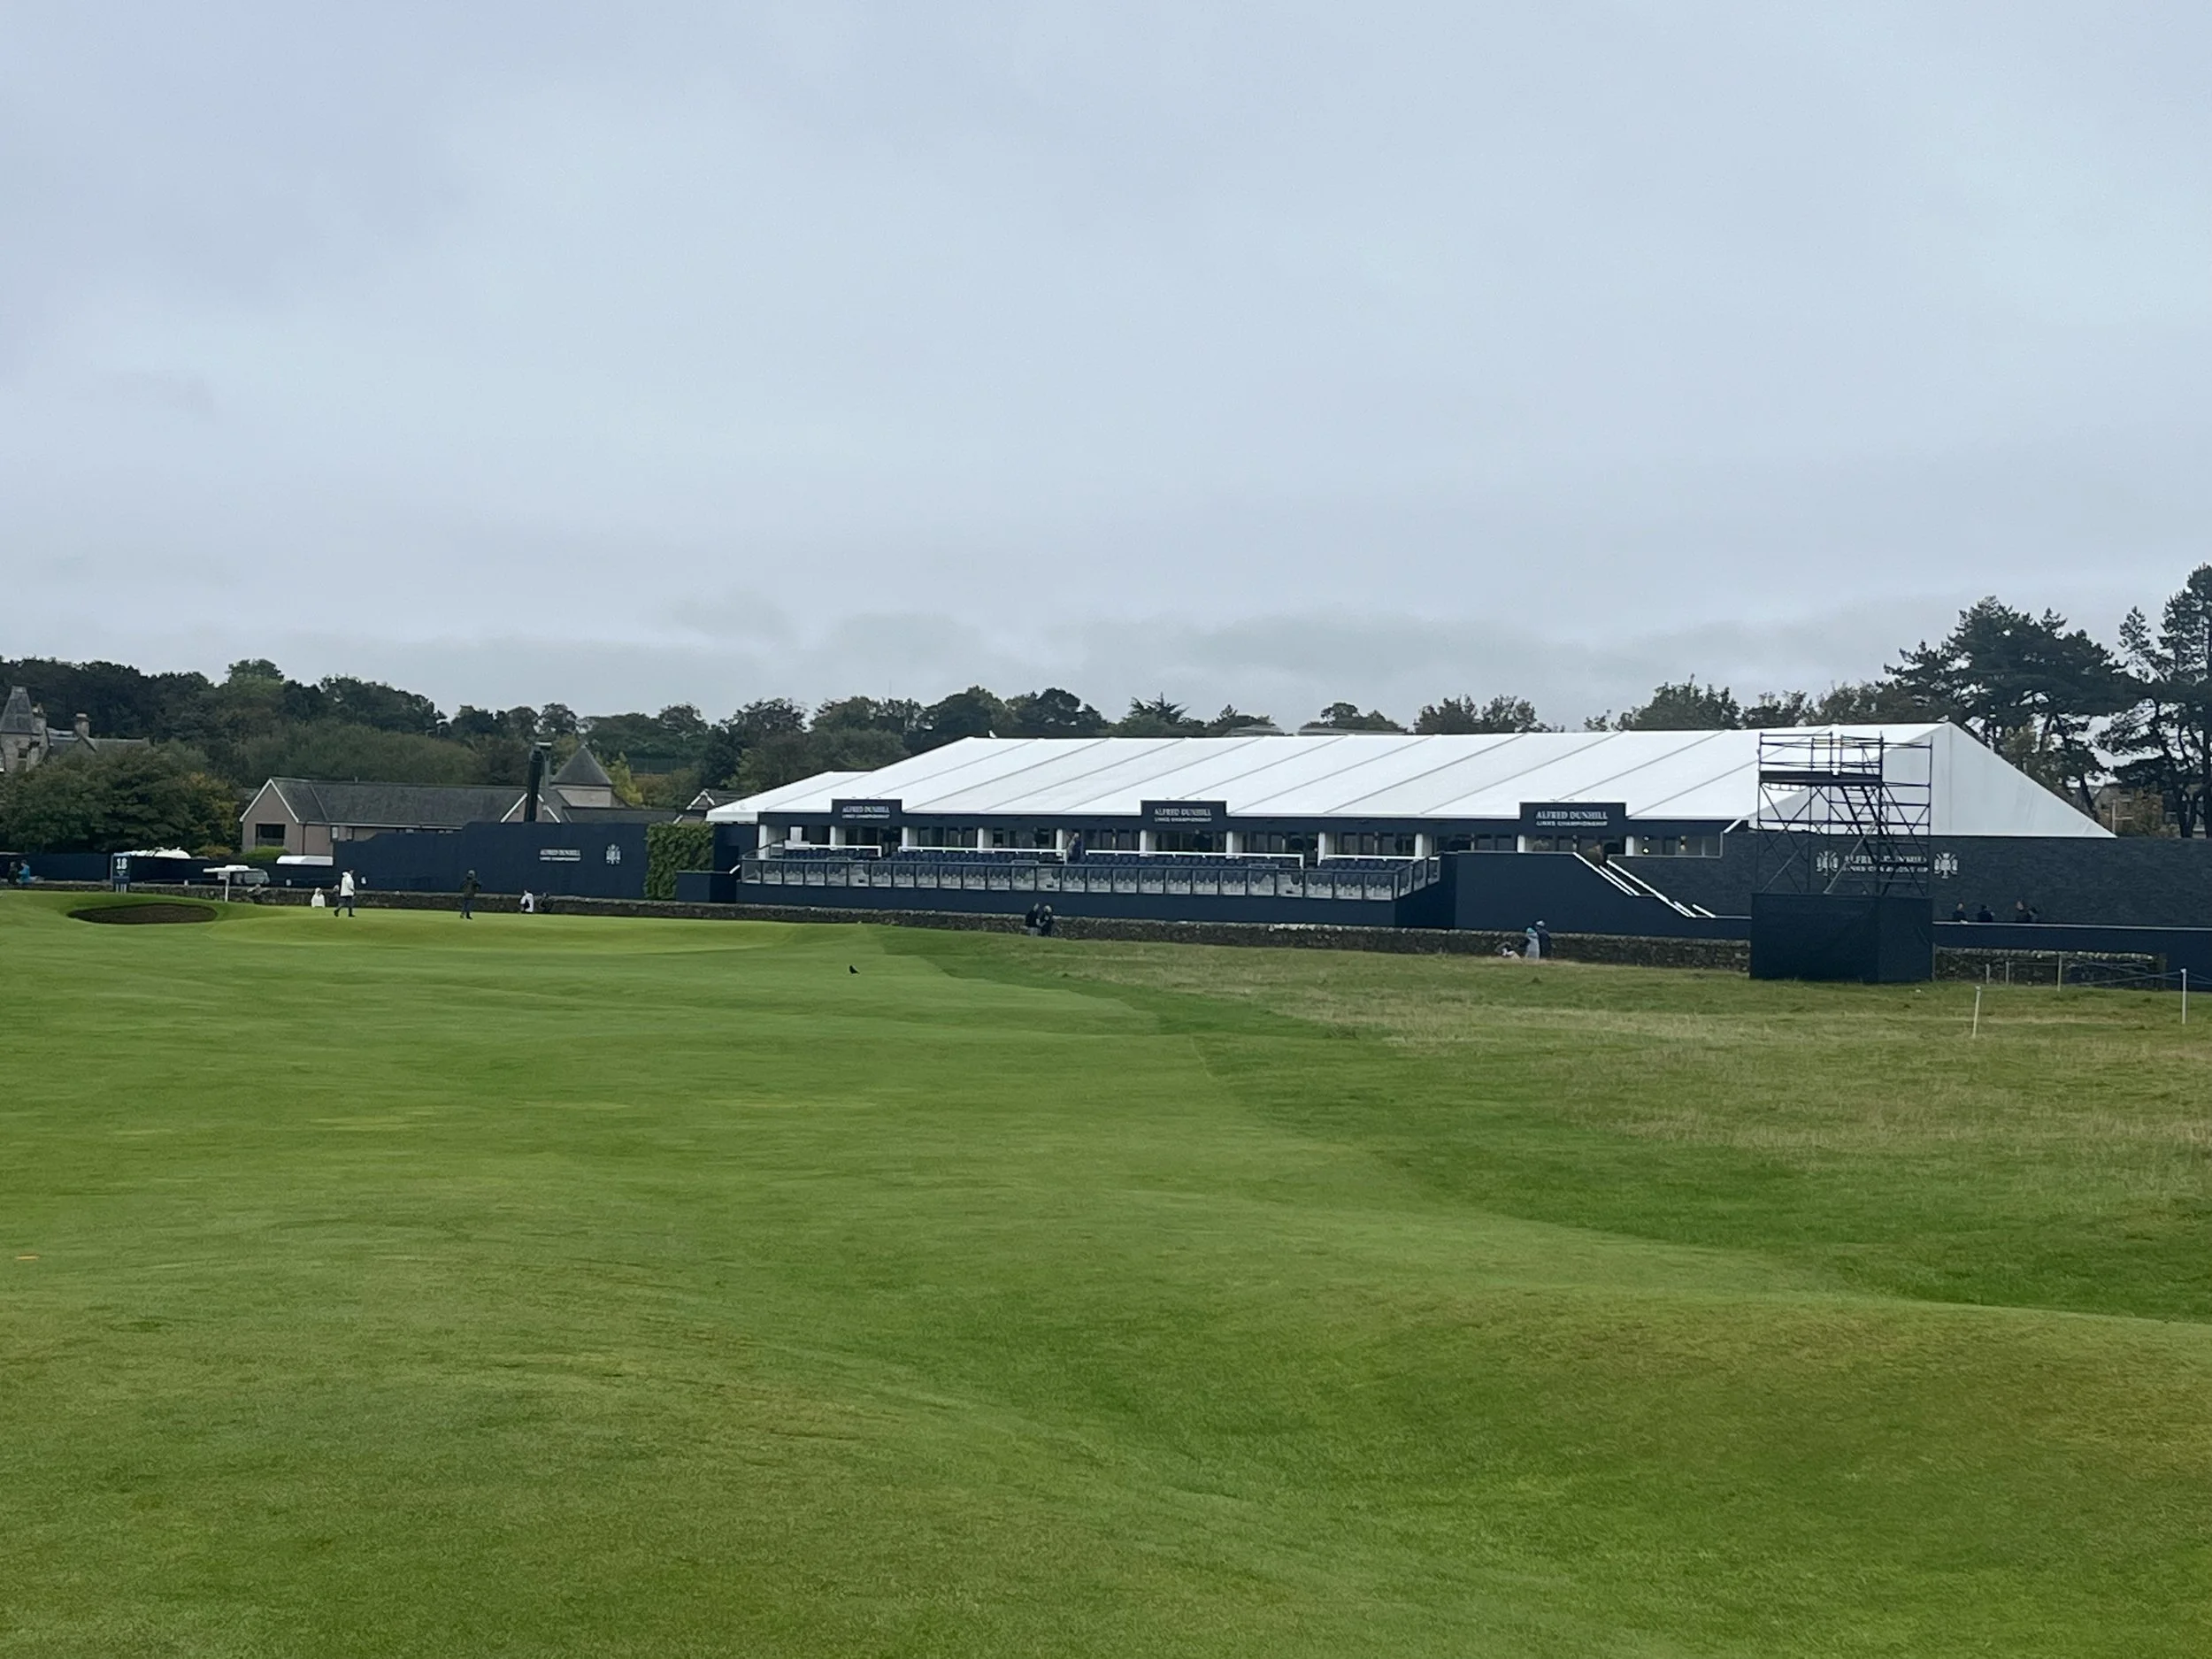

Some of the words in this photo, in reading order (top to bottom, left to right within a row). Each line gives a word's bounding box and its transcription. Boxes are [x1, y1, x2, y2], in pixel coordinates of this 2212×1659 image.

[1536, 810, 1568, 819] ALFRED
[1570, 810, 1608, 819] DUNHILL
[116, 857, 127, 869] 18
